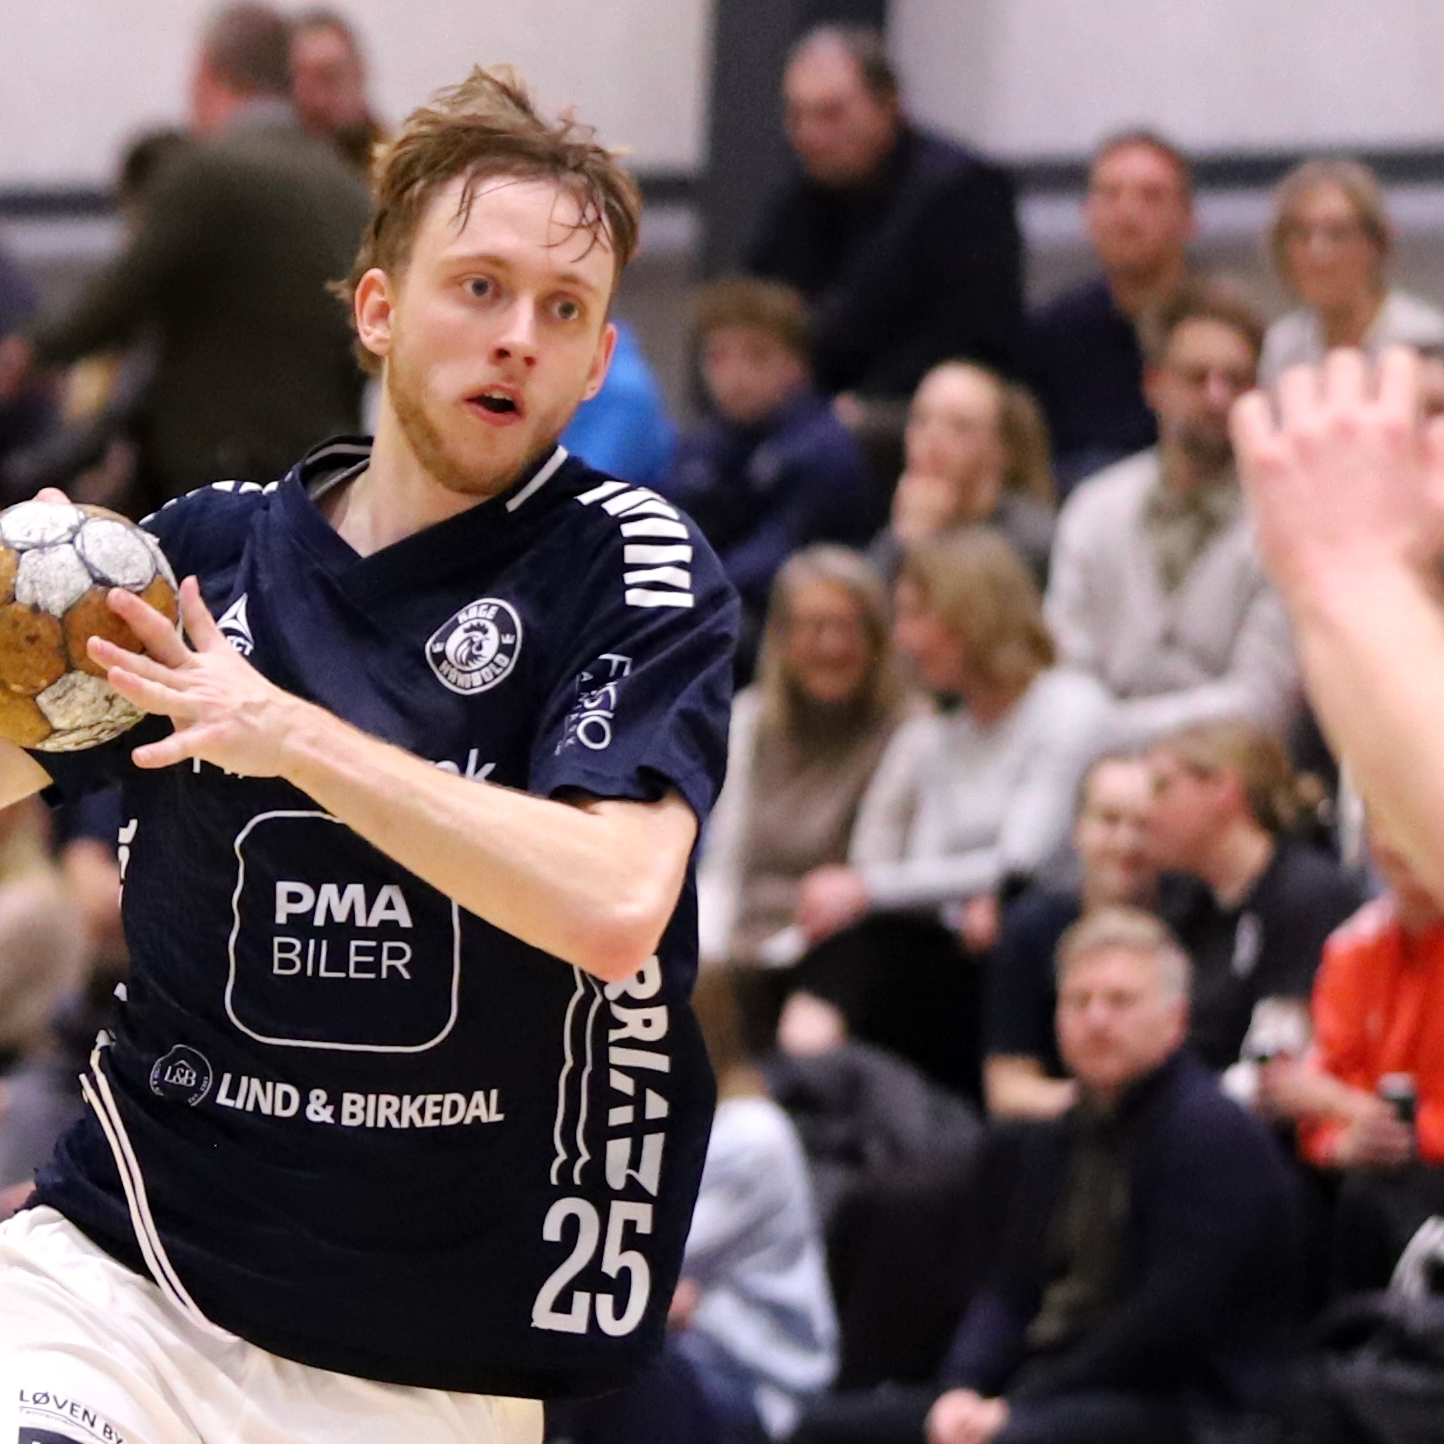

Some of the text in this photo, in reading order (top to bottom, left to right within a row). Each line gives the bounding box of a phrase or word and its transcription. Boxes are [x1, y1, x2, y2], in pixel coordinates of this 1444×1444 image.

[274, 880, 414, 929] PMA
[272, 936, 413, 980] BILER
[215, 1072, 301, 1118] LIND
[306, 1088, 335, 1124] &
[341, 1088, 506, 1129] BIRKEDAL
[530, 1196, 654, 1338] 25
[18, 1388, 98, 1429] LØVEN
